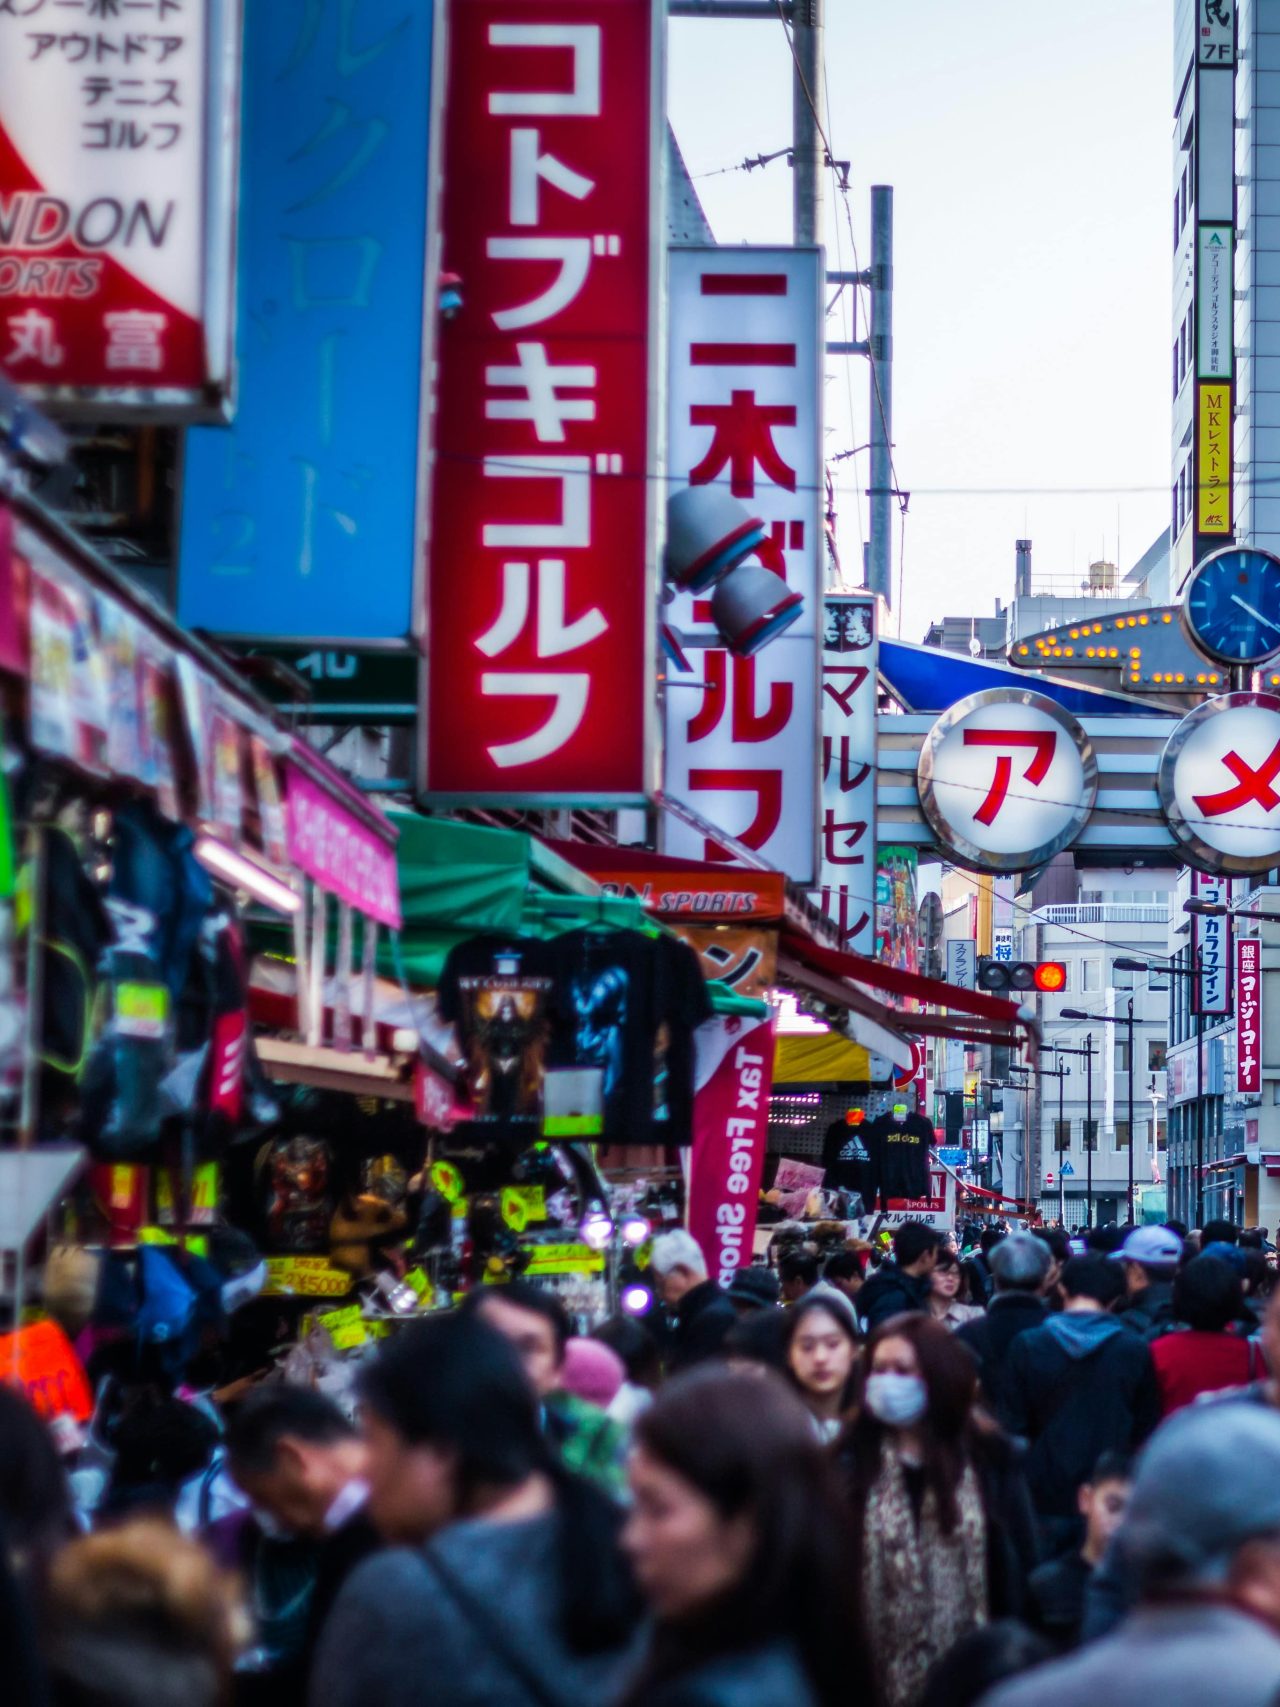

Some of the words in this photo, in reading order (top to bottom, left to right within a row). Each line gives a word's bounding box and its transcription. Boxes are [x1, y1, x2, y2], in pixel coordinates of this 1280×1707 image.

[25, 32, 184, 63] アウトドア
[1203, 44, 1231, 59] 7F
[81, 76, 182, 107] テニス
[81, 118, 182, 150] ゴルフ
[473, 24, 623, 769] コトブキゴルフ
[822, 665, 871, 945] マルセル
[658, 892, 758, 912] SPORTS
[1205, 890, 1219, 1005] コカラファイン
